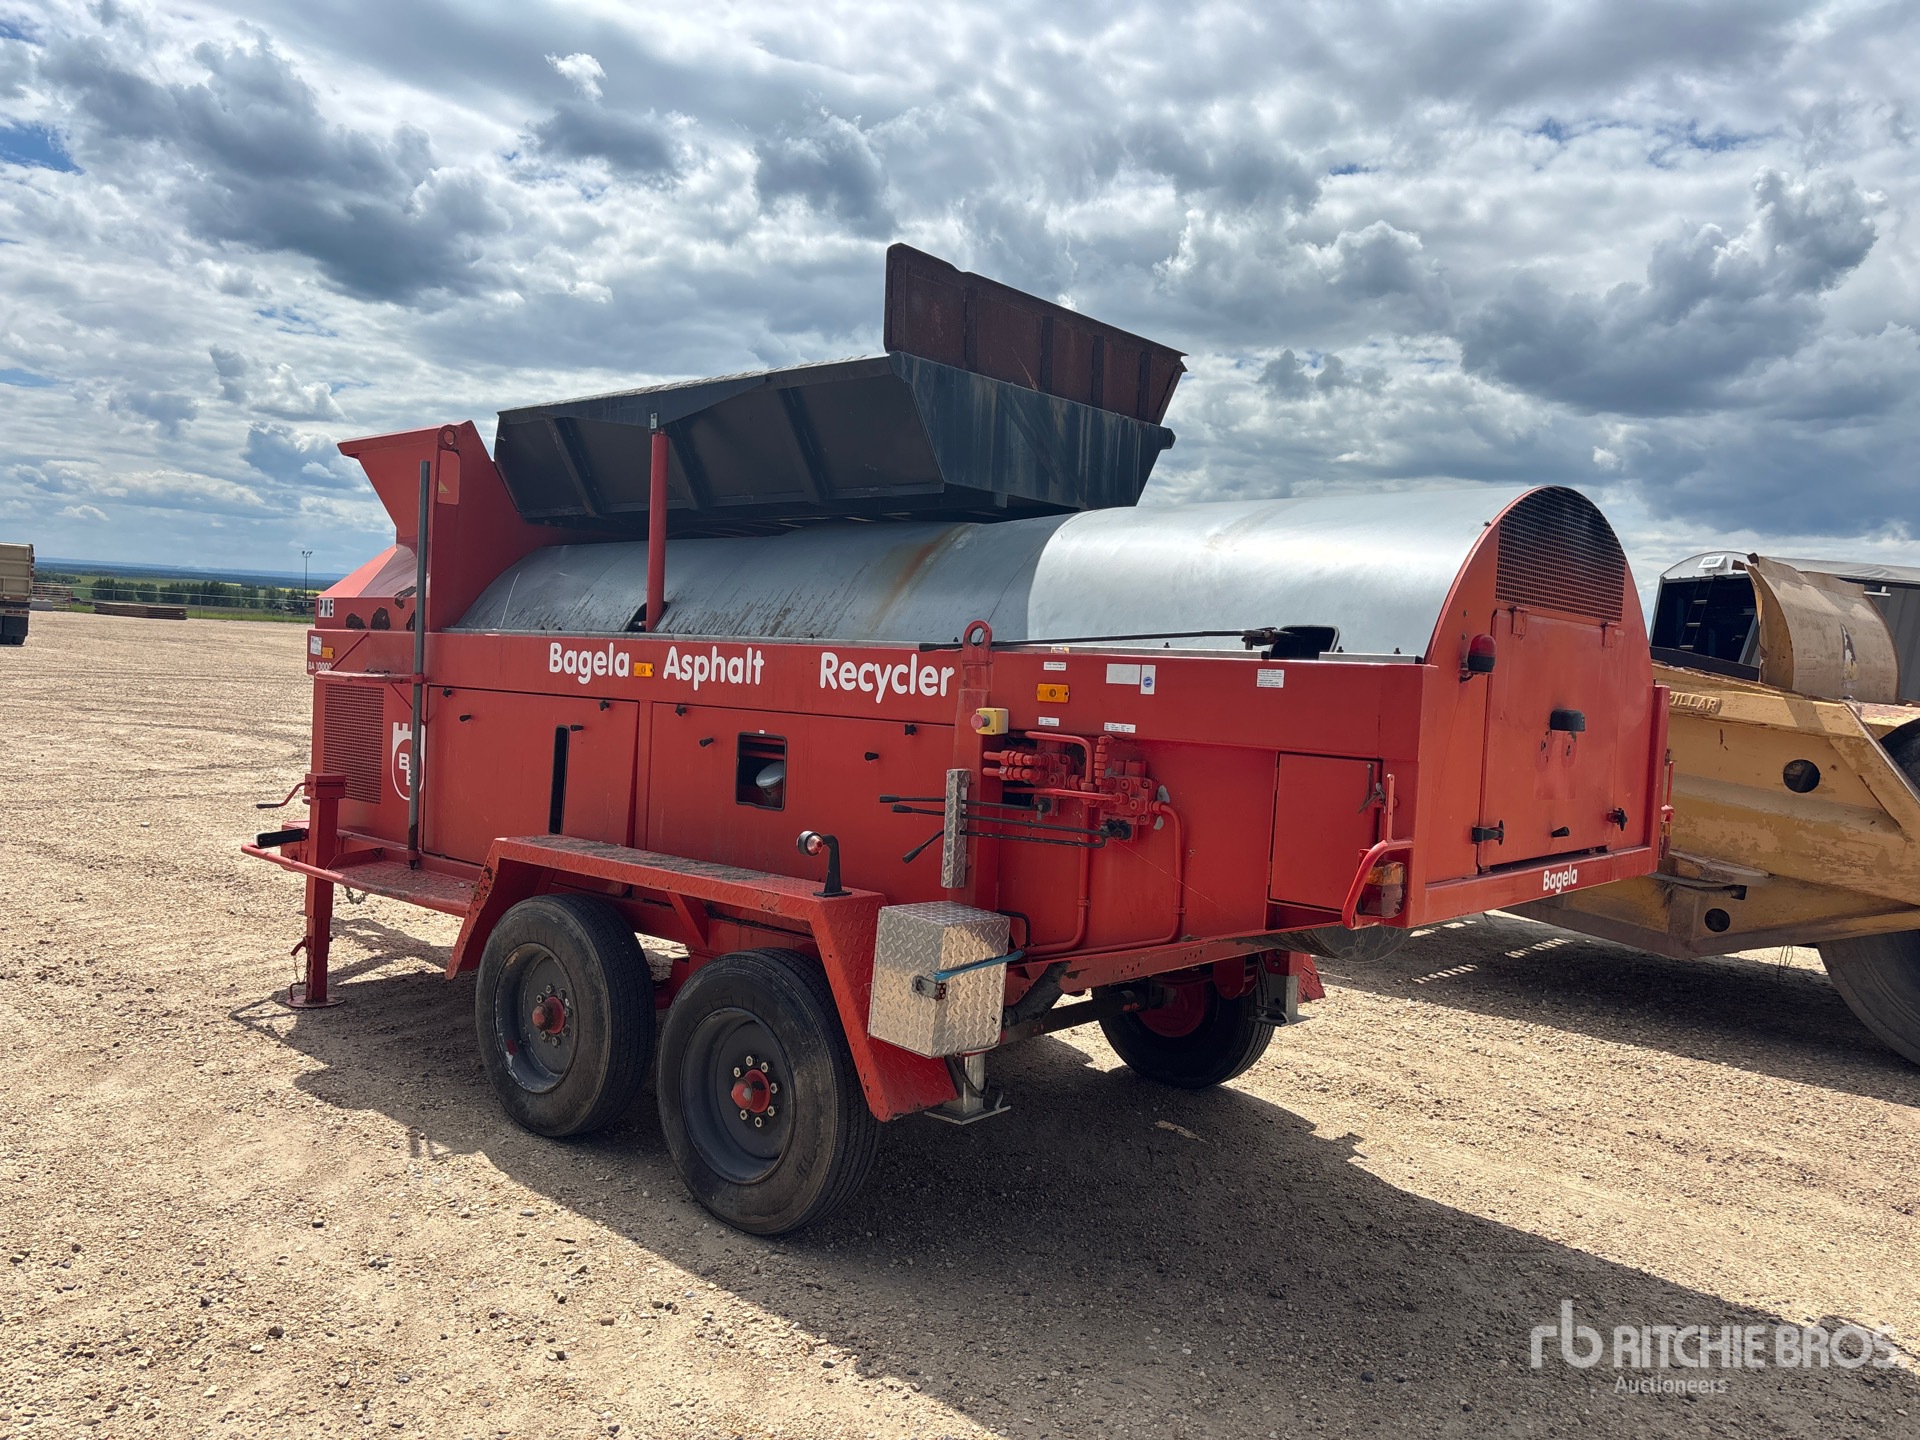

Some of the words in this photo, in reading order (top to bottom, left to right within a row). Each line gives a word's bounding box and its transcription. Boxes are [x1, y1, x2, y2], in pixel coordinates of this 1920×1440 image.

[549, 642, 630, 684] Bagela
[663, 645, 765, 691] Asphalt
[819, 651, 955, 704] Recycler
[1669, 692, 1718, 712] ILLAR
[1542, 864, 1578, 894] Bagela
